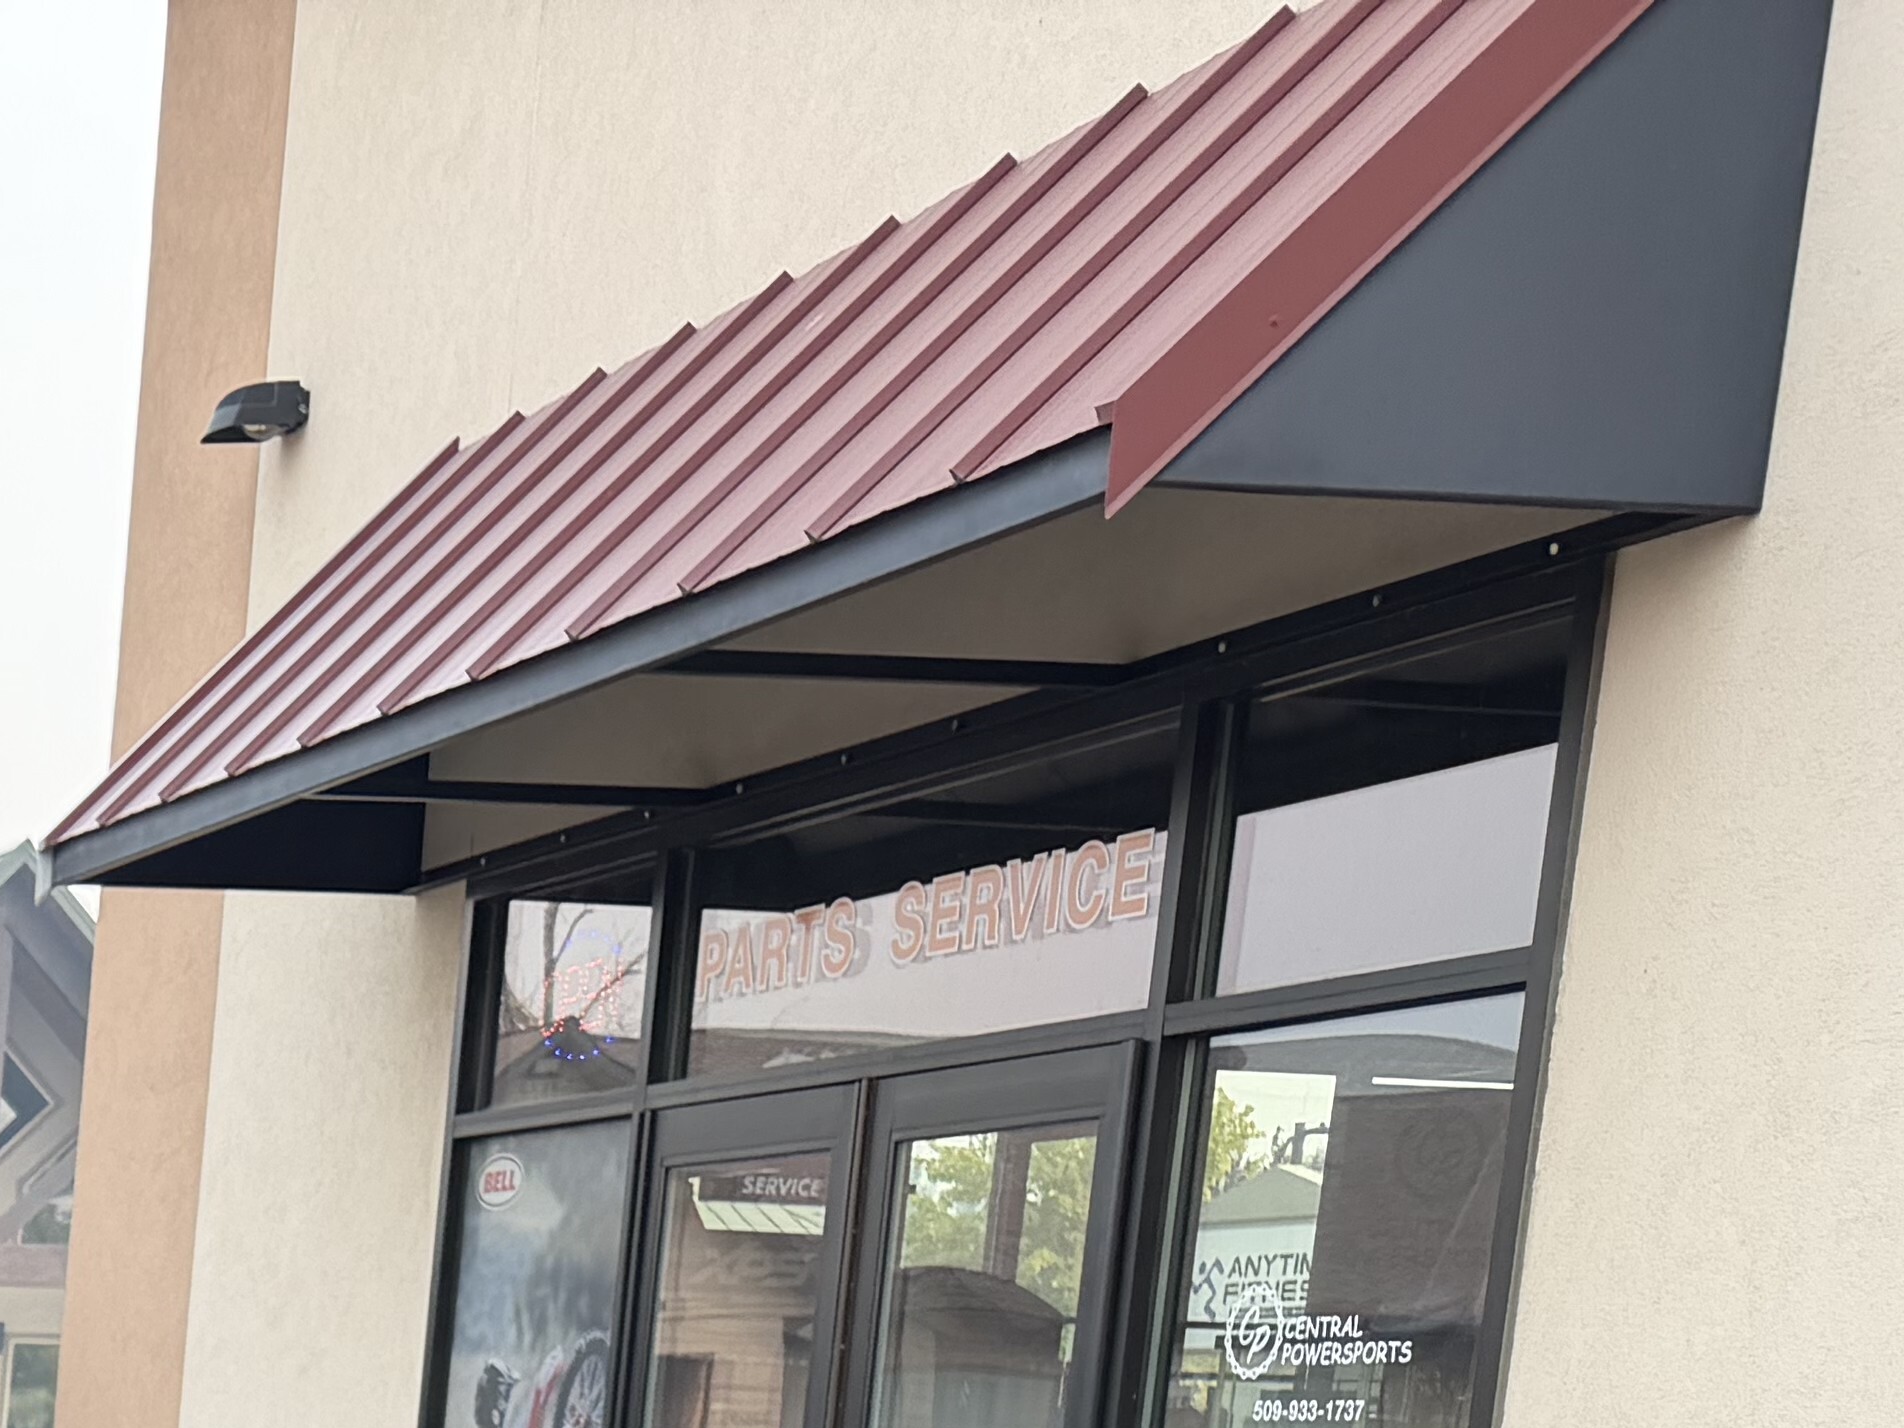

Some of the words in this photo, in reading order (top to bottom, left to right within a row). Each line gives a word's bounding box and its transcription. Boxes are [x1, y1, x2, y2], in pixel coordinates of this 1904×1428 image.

[698, 897, 856, 998] PARTS
[891, 827, 1156, 966] SERVICE
[483, 1169, 517, 1195] BELL
[742, 1174, 823, 1198] SERVICE
[1284, 1315, 1363, 1339] CENTRAL
[1281, 1341, 1413, 1366] POWERSPORTS
[1252, 1399, 1365, 1422] 509-933-1737
